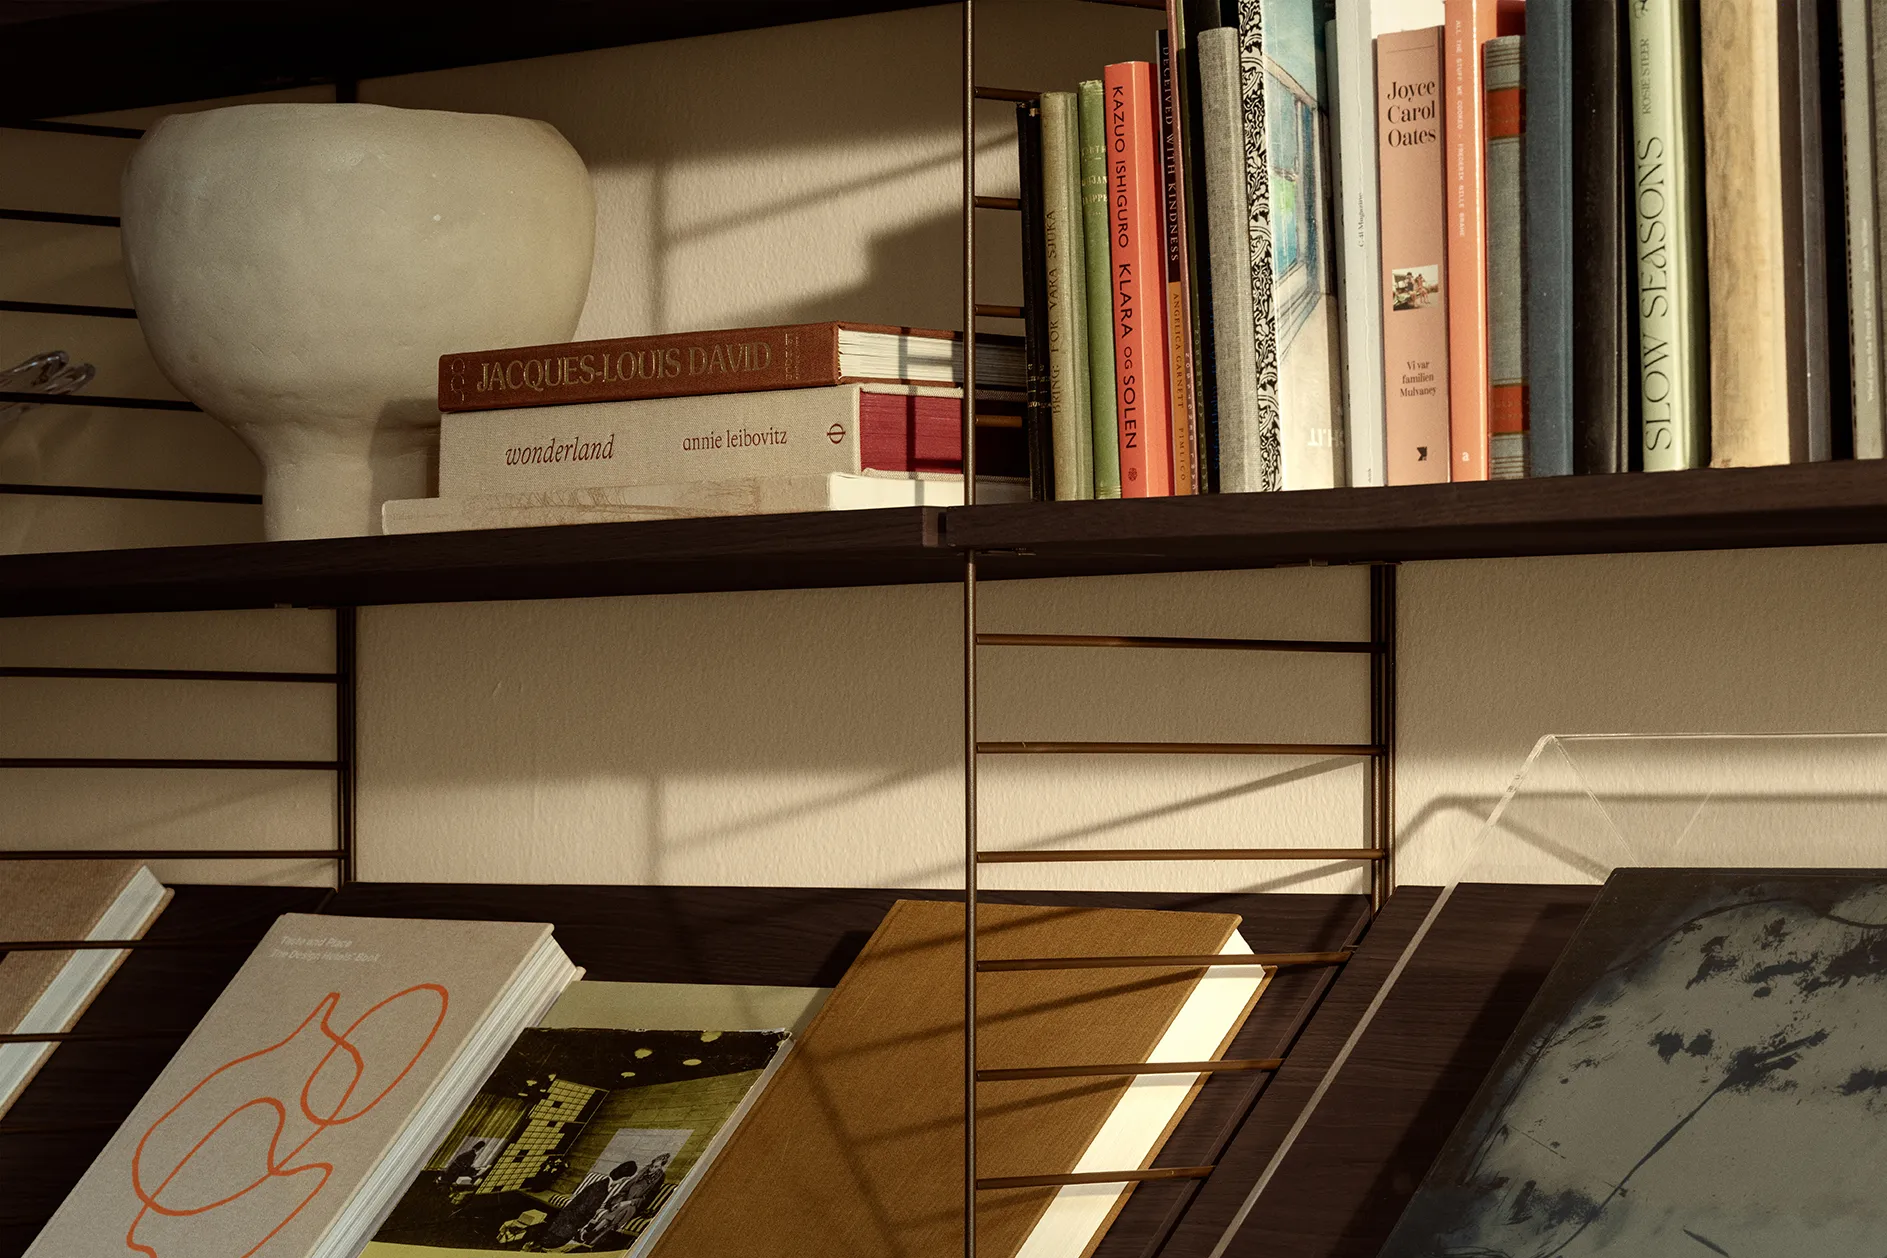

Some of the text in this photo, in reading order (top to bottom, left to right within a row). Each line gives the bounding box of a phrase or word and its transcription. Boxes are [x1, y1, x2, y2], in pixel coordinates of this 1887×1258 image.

[1387, 79, 1437, 103] Joyce
[1456, 85, 1463, 97] WE
[1387, 102, 1436, 124] Carol
[1388, 128, 1437, 148] Oates
[1161, 46, 1179, 262] DECEIVED WITH KINDNESS
[1457, 143, 1465, 181] FREDERIK
[1113, 85, 1137, 450] KAZUO ISHIGURO KLARA OG SOLEN
[1637, 136, 1672, 451] SLOW SEASONS
[476, 349, 682, 392] JACQUES-LOUIS
[687, 341, 772, 376] DAVID
[1407, 360, 1430, 370] Vi var
[1172, 293, 1187, 482] ANGELICA GARNETT PIMLICO
[1402, 372, 1435, 385] familien
[1400, 384, 1437, 398] Mulvaney
[504, 434, 615, 467] wonderland
[683, 427, 788, 451] annie leibovitz
